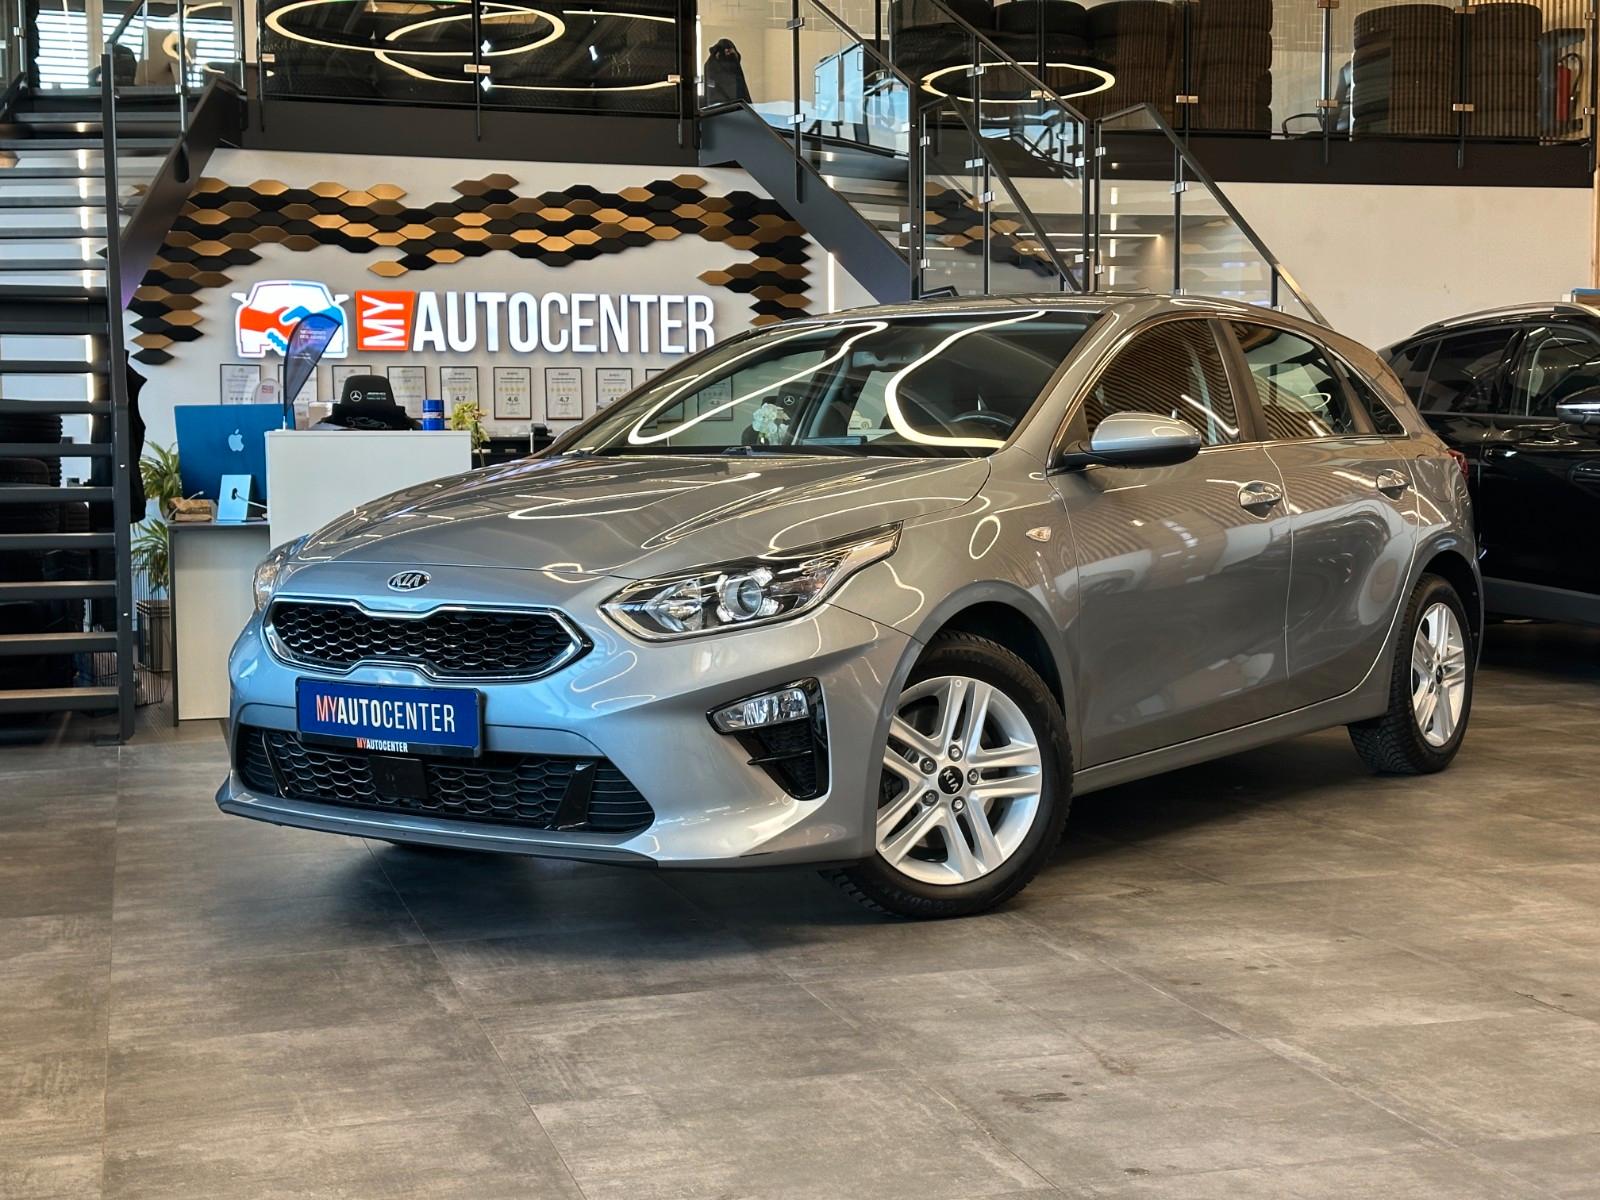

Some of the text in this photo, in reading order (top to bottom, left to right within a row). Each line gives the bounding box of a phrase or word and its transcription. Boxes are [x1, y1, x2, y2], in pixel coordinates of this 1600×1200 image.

[361, 291, 715, 353] MY AUTOCENTER
[316, 694, 456, 733] MYAUTOCENTER
[356, 737, 409, 753] MYAUTOCENTER
[943, 769, 959, 792] KIA
